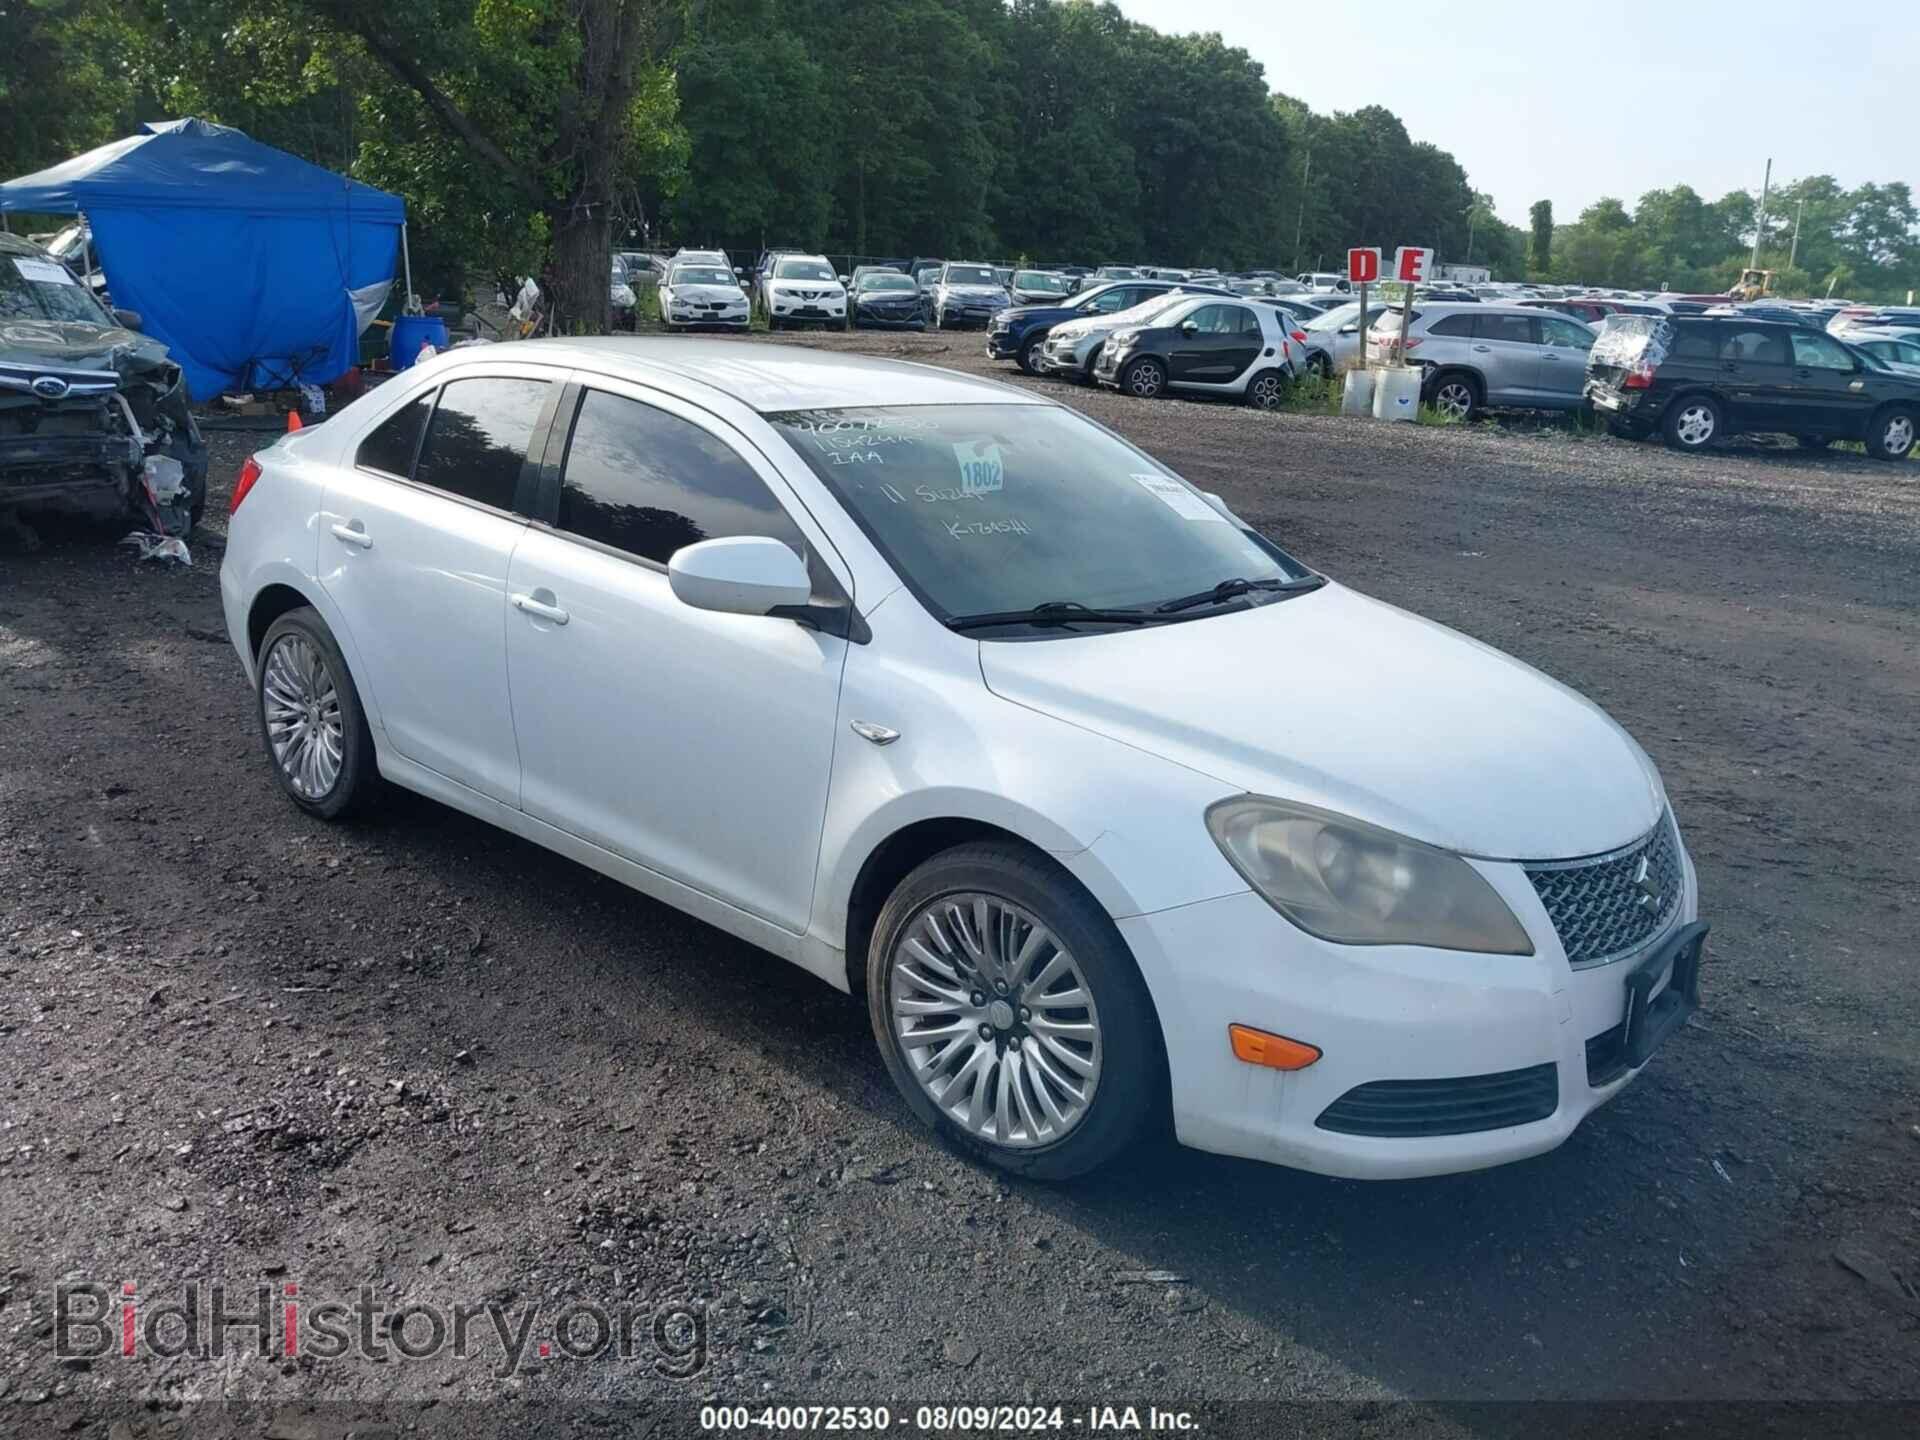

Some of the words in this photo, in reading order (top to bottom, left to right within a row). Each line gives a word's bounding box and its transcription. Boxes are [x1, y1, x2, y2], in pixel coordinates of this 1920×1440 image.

[1350, 250, 1378, 282] D
[1400, 250, 1424, 282] E
[963, 461, 1001, 488] 1802
